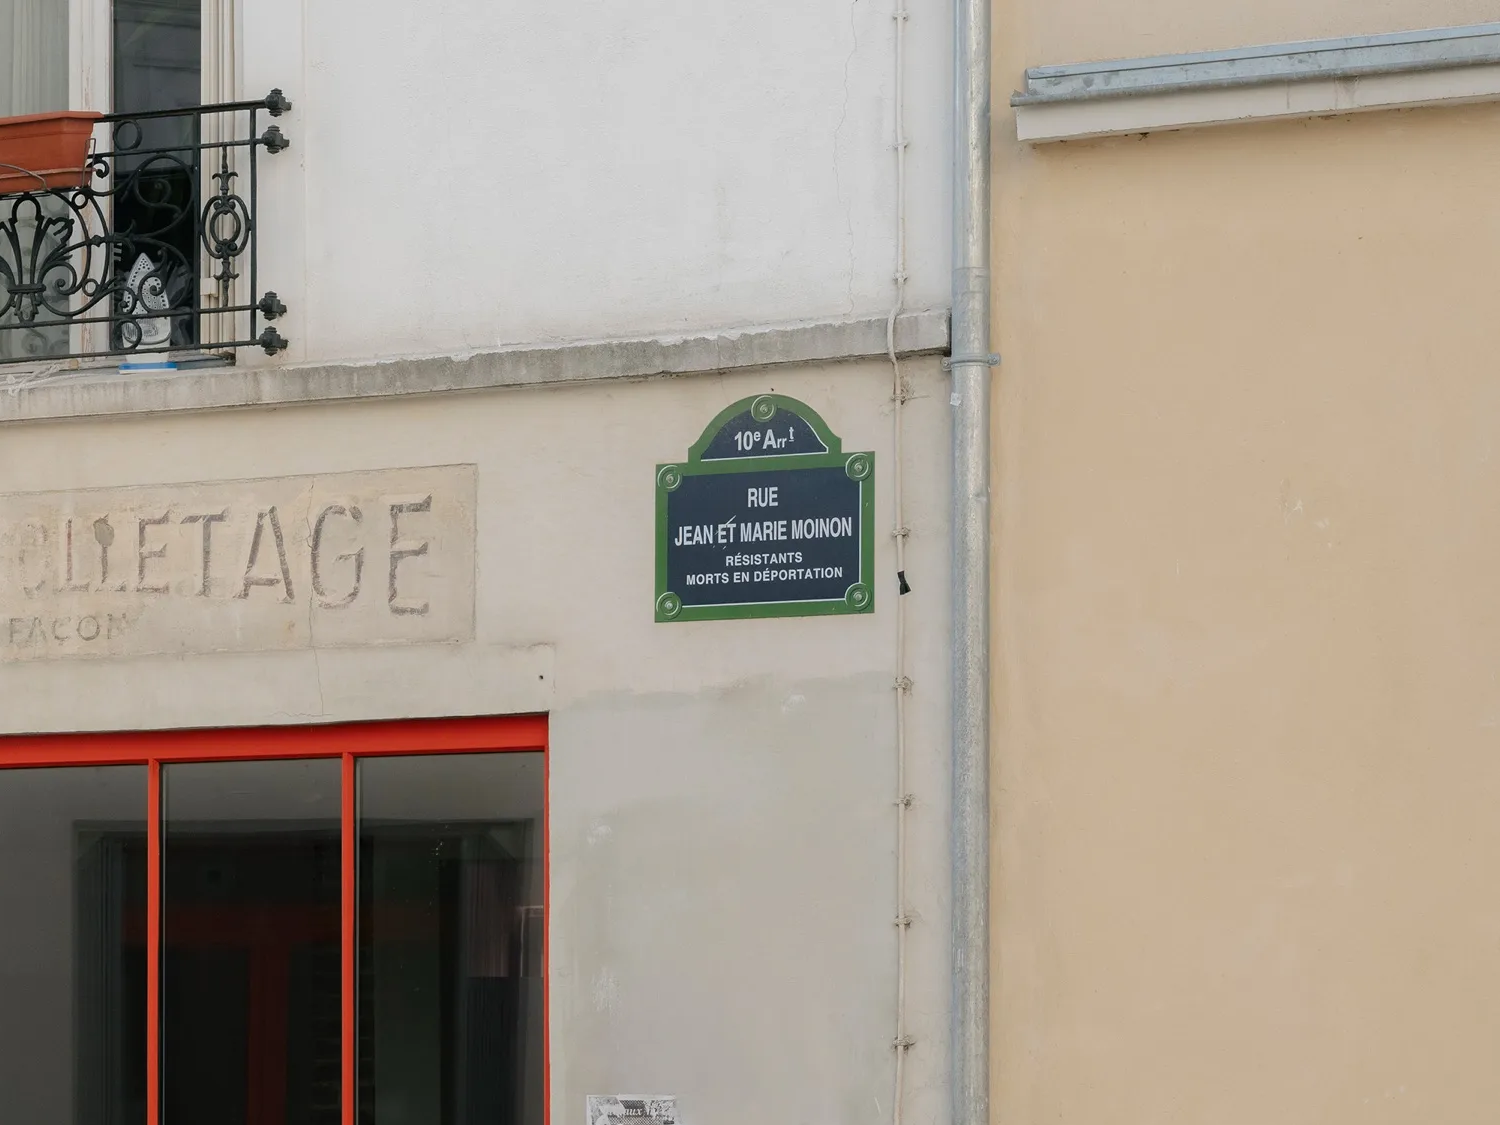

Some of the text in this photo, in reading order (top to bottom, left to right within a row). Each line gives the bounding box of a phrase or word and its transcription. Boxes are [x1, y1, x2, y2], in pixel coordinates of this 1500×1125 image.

[734, 429, 761, 451] 10e
[747, 486, 779, 507] RUE
[674, 517, 852, 546] JEAN ET MARIE MOINON
[725, 551, 803, 567] RÉSISTANTS
[686, 566, 843, 585] MORTS EN DÉPORTATION
